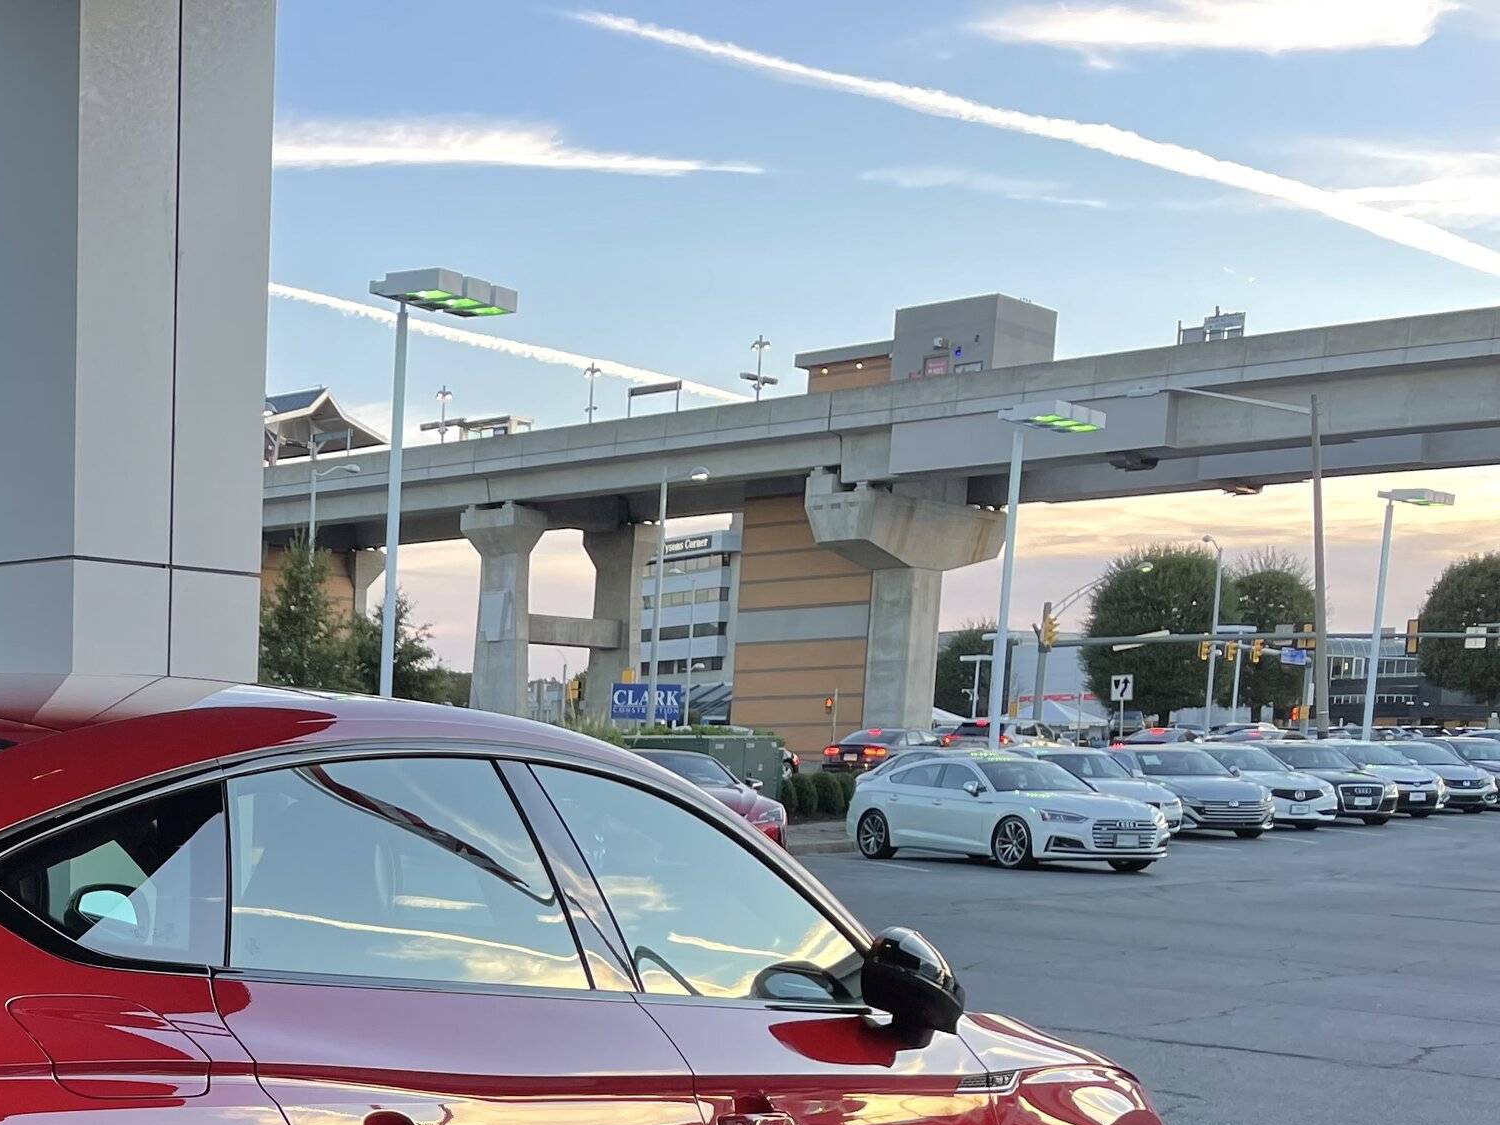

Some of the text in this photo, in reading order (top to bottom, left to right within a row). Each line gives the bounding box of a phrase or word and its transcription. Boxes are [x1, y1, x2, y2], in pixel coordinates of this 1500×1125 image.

[664, 538, 708, 554] ysons Corner
[613, 689, 679, 706] CLARK
